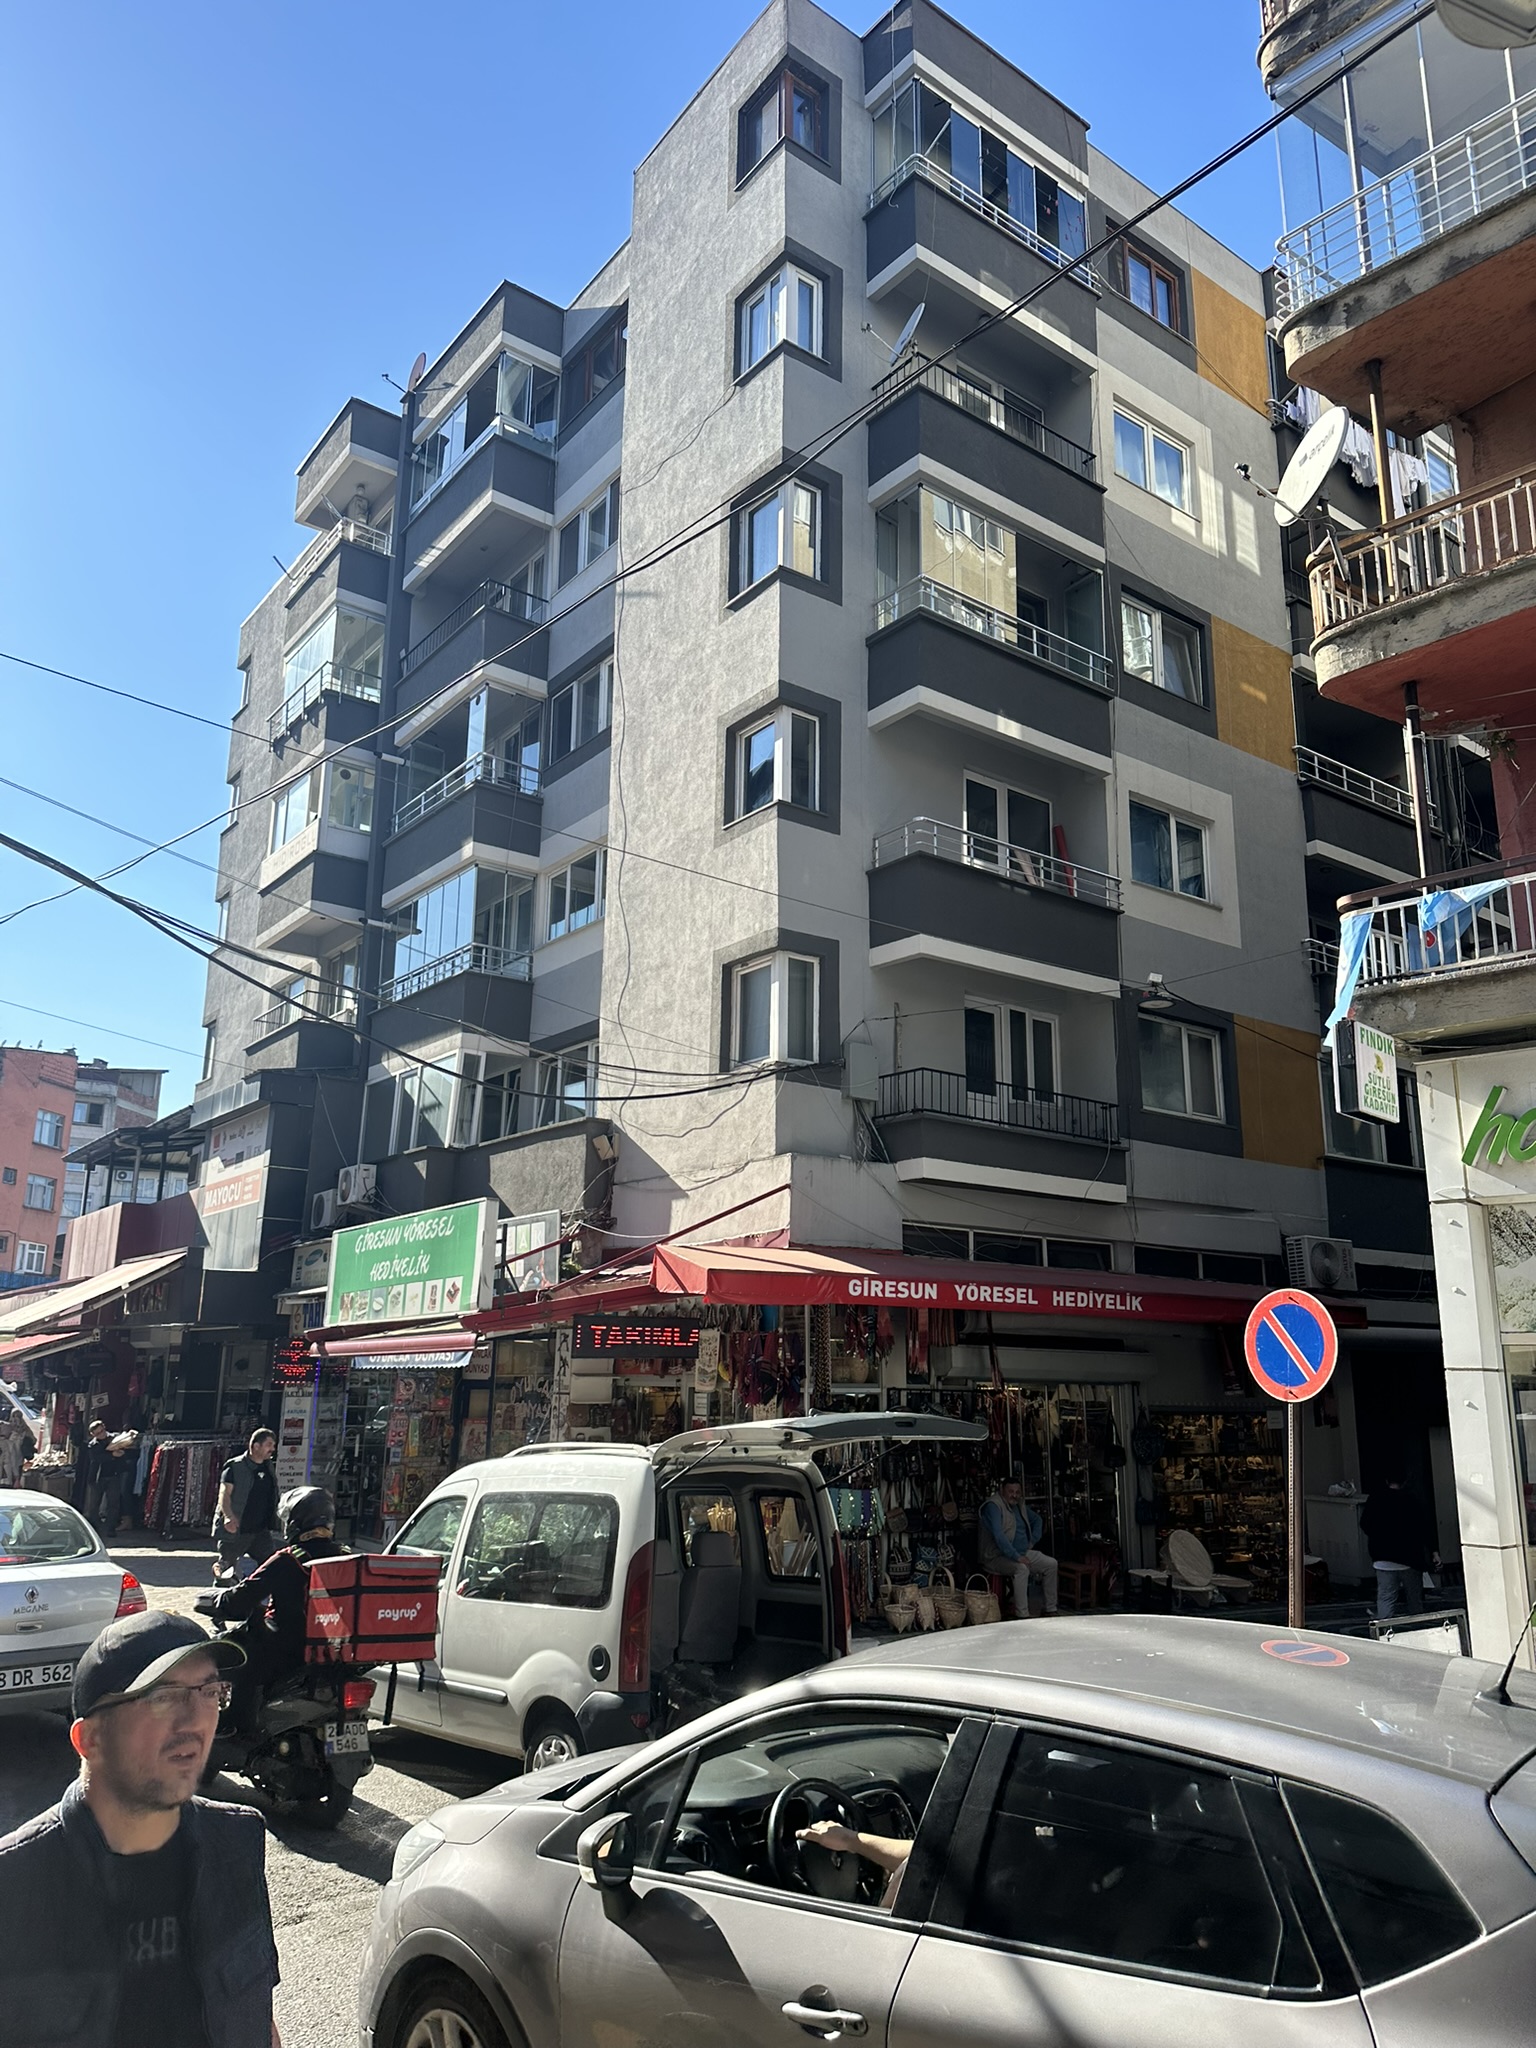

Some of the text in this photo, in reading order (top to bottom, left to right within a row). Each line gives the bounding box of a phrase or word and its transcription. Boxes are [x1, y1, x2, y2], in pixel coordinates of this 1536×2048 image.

[1360, 1027, 1394, 1057] FINDIK
[1368, 1071, 1390, 1090] SÜTLÜ
[1363, 1095, 1398, 1118] KADAYIFI
[354, 1214, 455, 1254] GİRESUN YÖRESEL
[370, 1250, 431, 1281] HEDİYELİK
[848, 1277, 1143, 1312] GİRESUN YÖRESEL HEDİYELİK
[13, 1604, 49, 1615] MEGANE
[12, 1669, 33, 1686] DR
[42, 1664, 71, 1683] 562
[336, 1737, 358, 1751] 546
